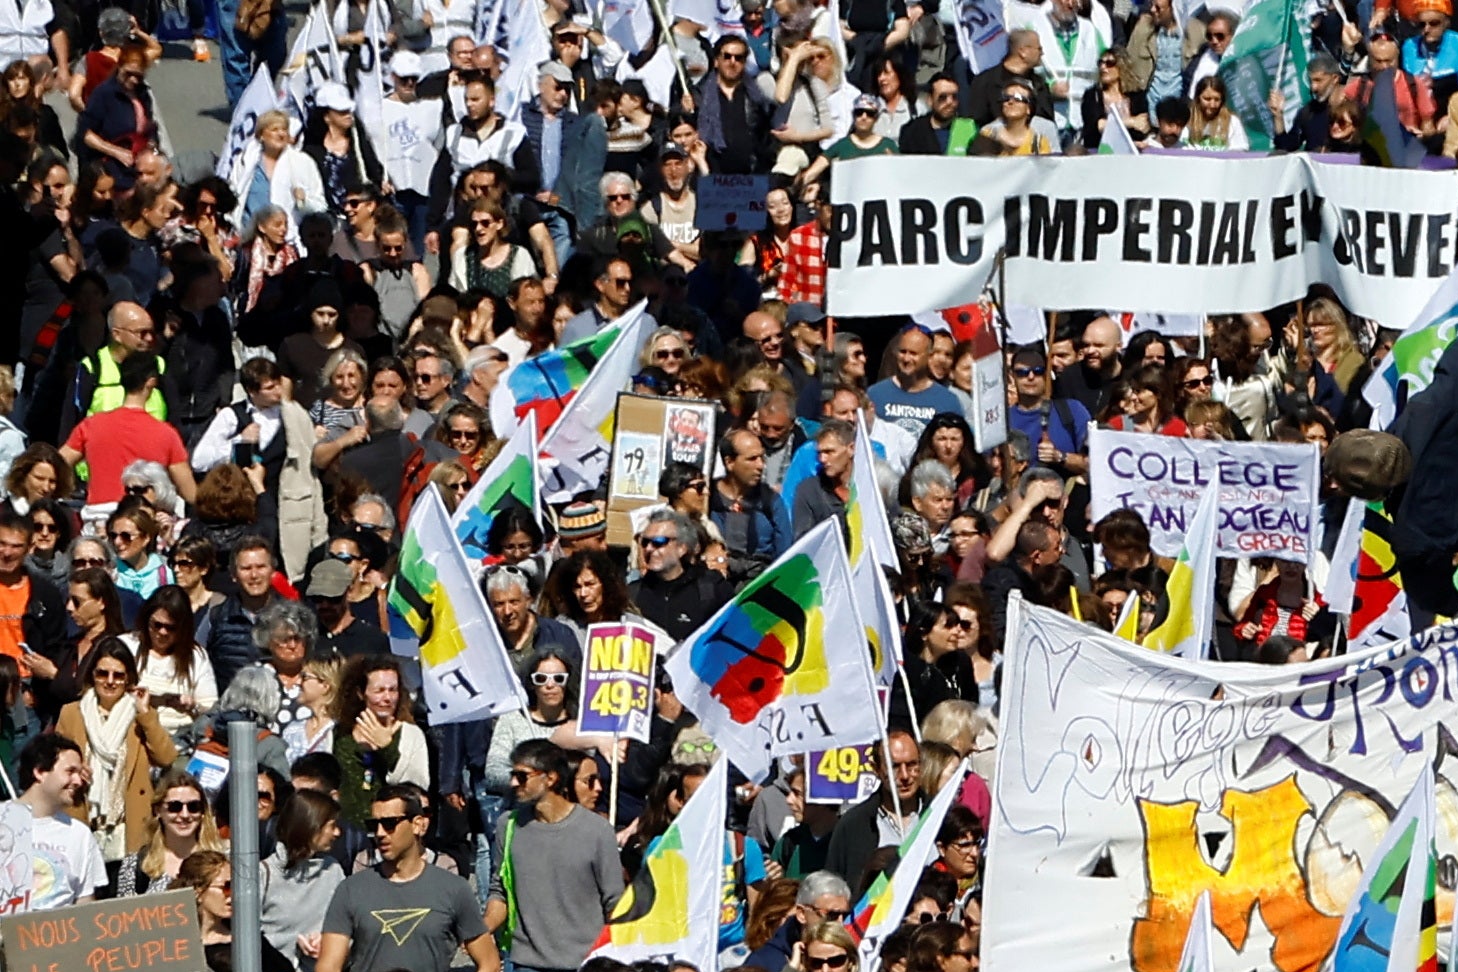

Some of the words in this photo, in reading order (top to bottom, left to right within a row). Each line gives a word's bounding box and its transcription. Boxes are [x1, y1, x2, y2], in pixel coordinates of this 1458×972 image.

[828, 196, 985, 269] PARC
[1004, 193, 1261, 264] IMPERIAL
[1107, 446, 1299, 492] COLLÈGE
[1216, 502, 1309, 534] OCTEAU
[589, 634, 652, 677] NON
[589, 679, 648, 717] 49.3
[16, 916, 82, 951] NOUS
[92, 902, 190, 941] SOMMES
